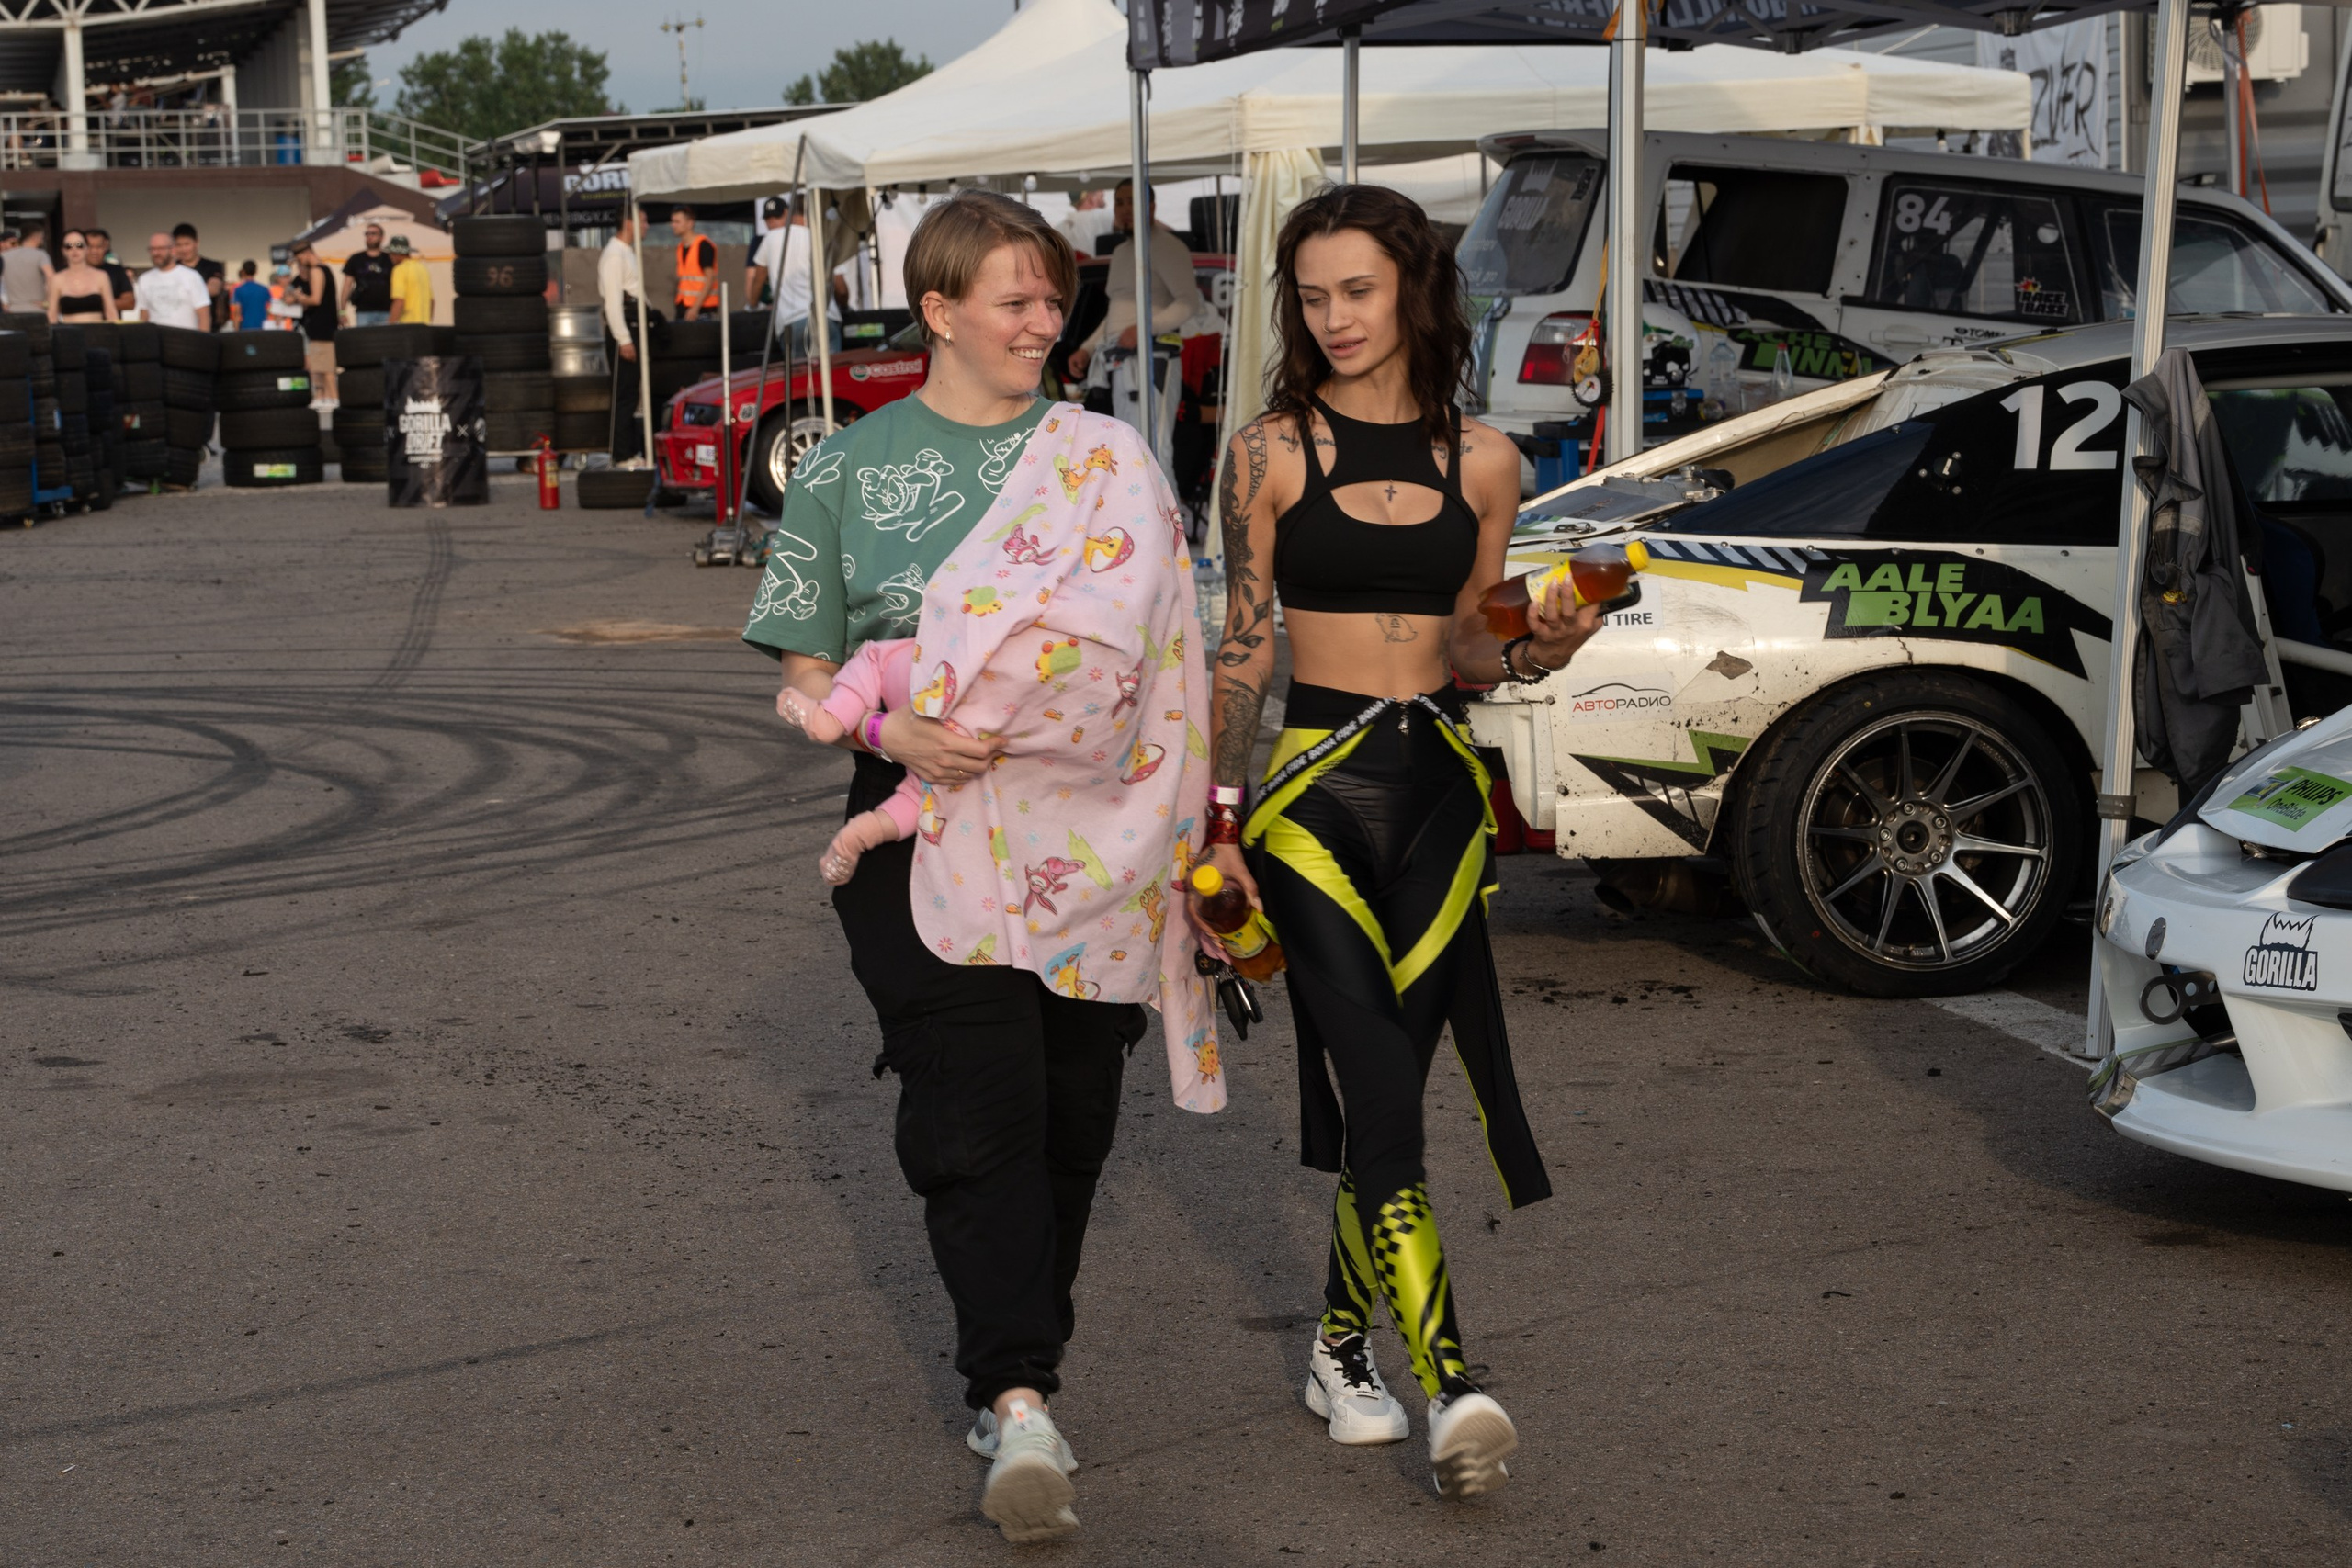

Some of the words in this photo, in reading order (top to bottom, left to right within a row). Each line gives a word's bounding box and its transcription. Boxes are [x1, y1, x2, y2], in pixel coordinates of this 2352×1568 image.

[1895, 193, 1951, 235] 84
[2021, 292, 2065, 304] RACE
[2024, 303, 2067, 316] BASE
[399, 413, 452, 434] GORILLA
[1999, 379, 2122, 470] 12
[405, 432, 446, 450] DRIFT
[1820, 562, 1967, 593] AALE
[1613, 612, 1654, 626] TIRE
[1883, 591, 2045, 634] BLYAA
[2284, 779, 2344, 807] PHILIPS
[2266, 798, 2307, 820] OneBlade
[2245, 947, 2317, 990] GORILLA
